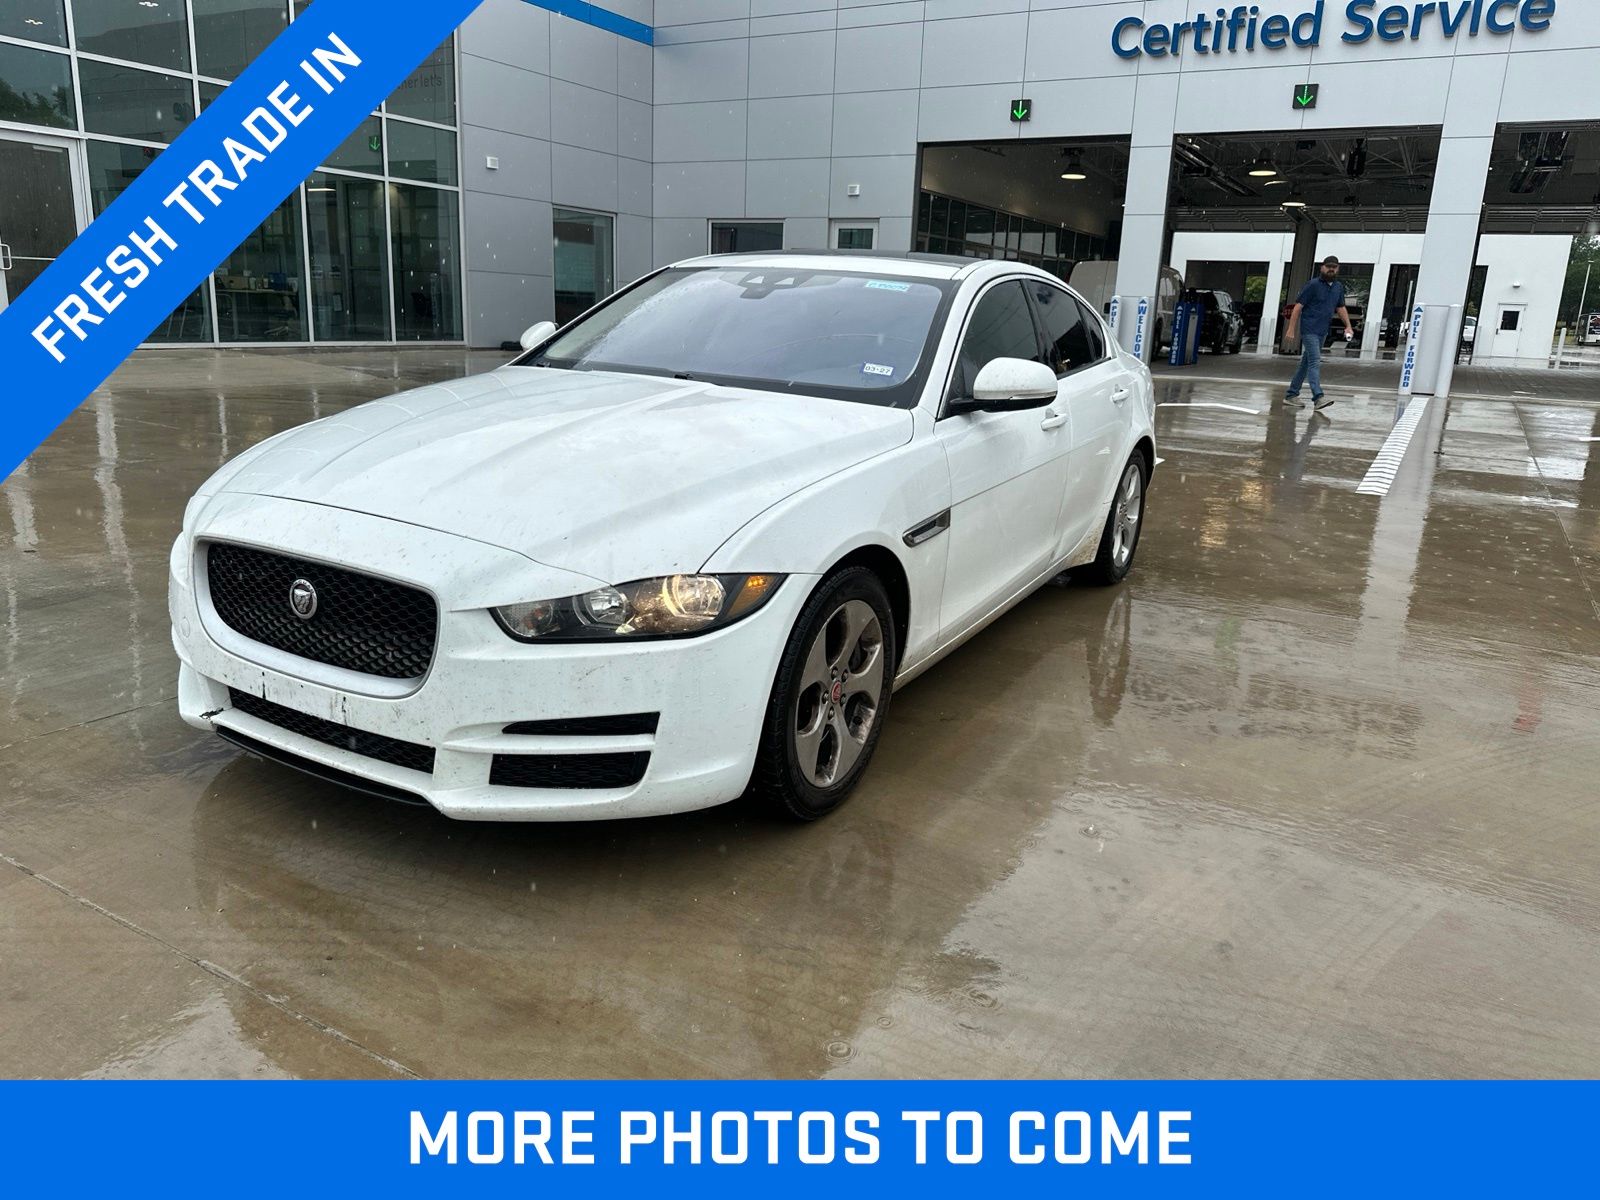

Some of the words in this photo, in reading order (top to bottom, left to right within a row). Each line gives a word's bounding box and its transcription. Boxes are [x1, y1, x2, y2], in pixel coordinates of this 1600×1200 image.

[1111, 0, 1325, 59] Certified
[1341, 0, 1557, 45] Service
[1411, 314, 1421, 339] PULL
[1402, 345, 1415, 388] FORWARD
